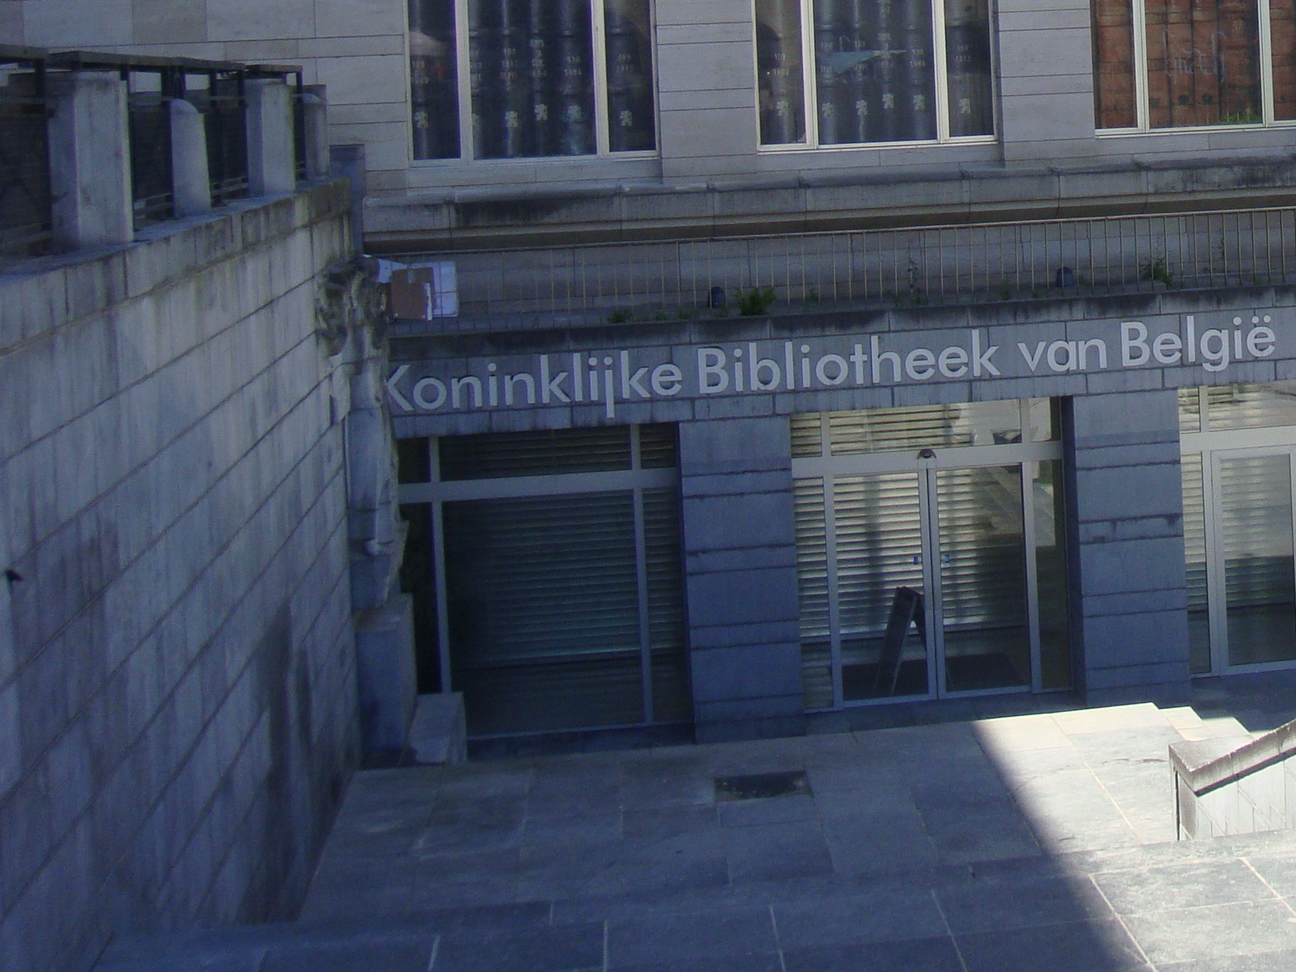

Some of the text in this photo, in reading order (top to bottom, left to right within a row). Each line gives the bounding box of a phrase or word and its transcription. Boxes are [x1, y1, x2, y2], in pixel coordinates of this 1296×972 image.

[385, 349, 683, 419] Koninklijke
[697, 328, 1001, 396] Bibliotheek
[1018, 336, 1107, 373] van
[1120, 314, 1276, 372] België
